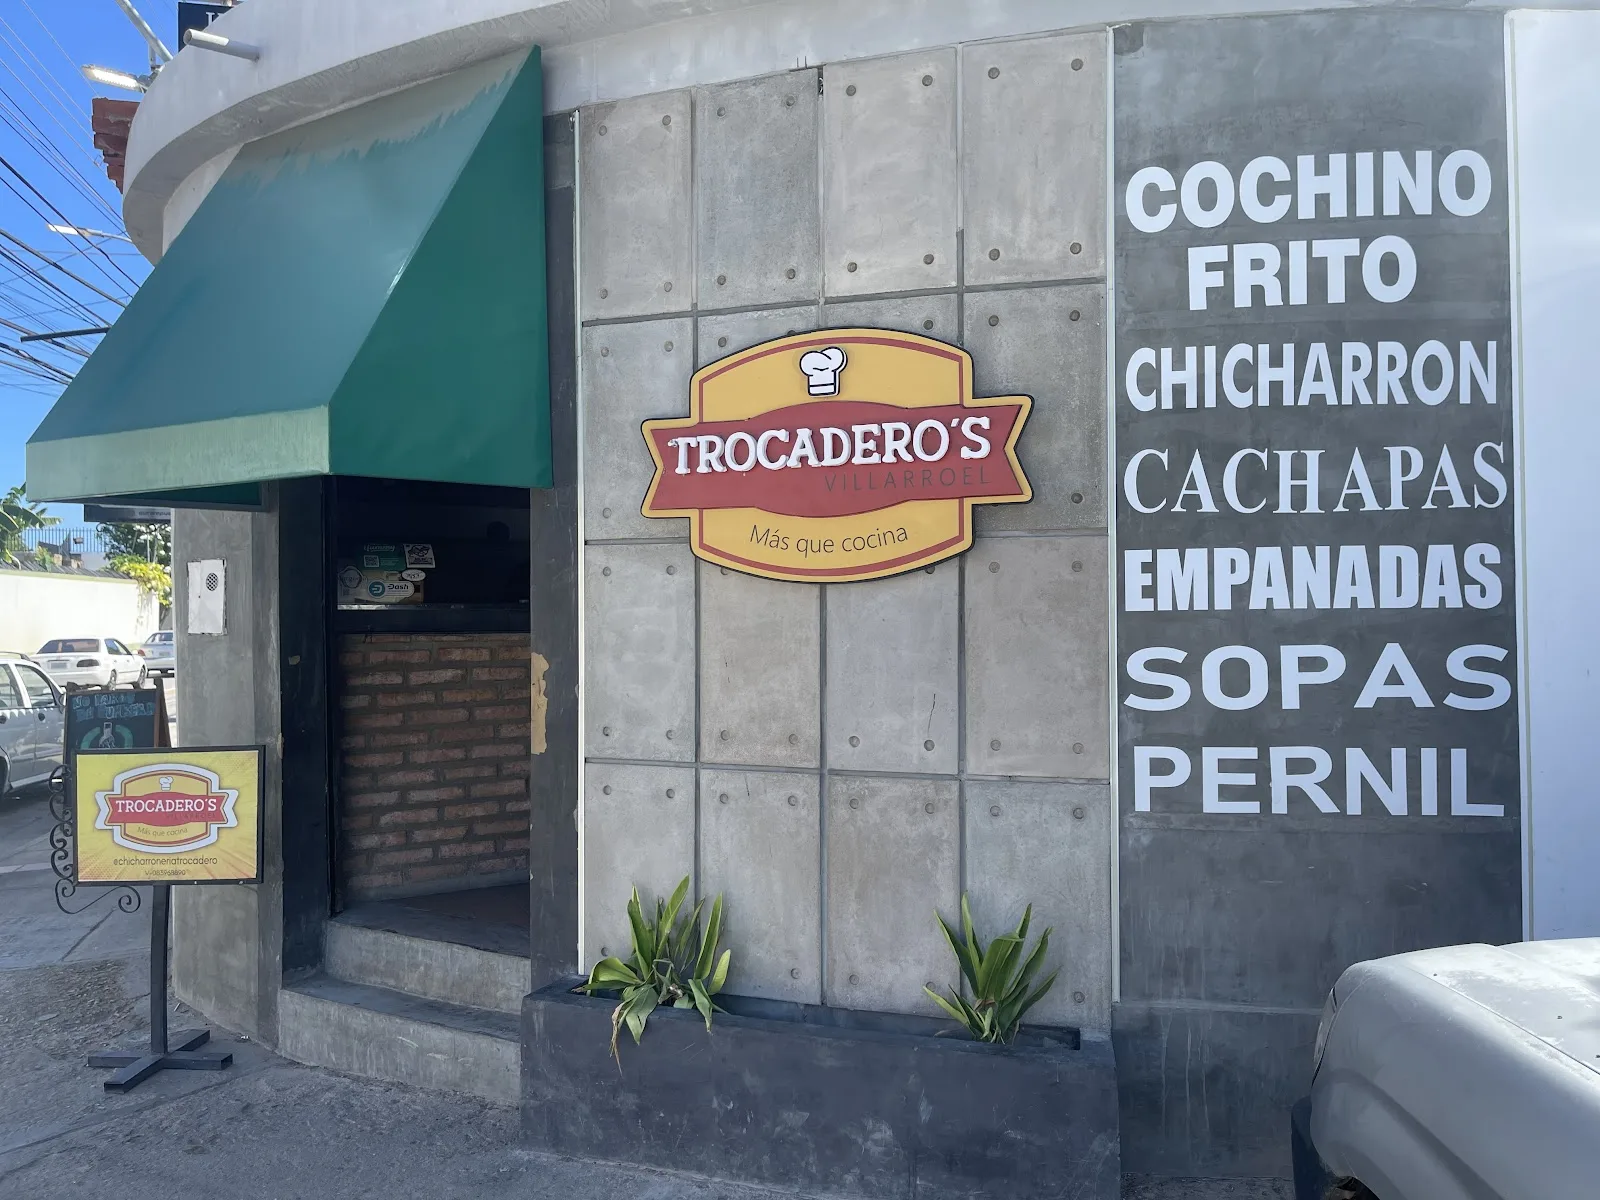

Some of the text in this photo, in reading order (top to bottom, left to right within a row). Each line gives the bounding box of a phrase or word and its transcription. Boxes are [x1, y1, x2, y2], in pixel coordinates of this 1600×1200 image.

[1125, 149, 1492, 233] COCHINO
[1188, 235, 1417, 311] FRITO
[1125, 340, 1497, 411] CHICHARRON
[825, 465, 991, 493] VILLARROEL
[1123, 441, 1508, 514] CACHAPAS
[749, 524, 908, 559] Más que cocina
[1124, 542, 1503, 612] EMPANADAS
[1123, 643, 1512, 712] SOPAS
[1133, 746, 1505, 817] PERNIL
[166, 827, 188, 837] cocina
